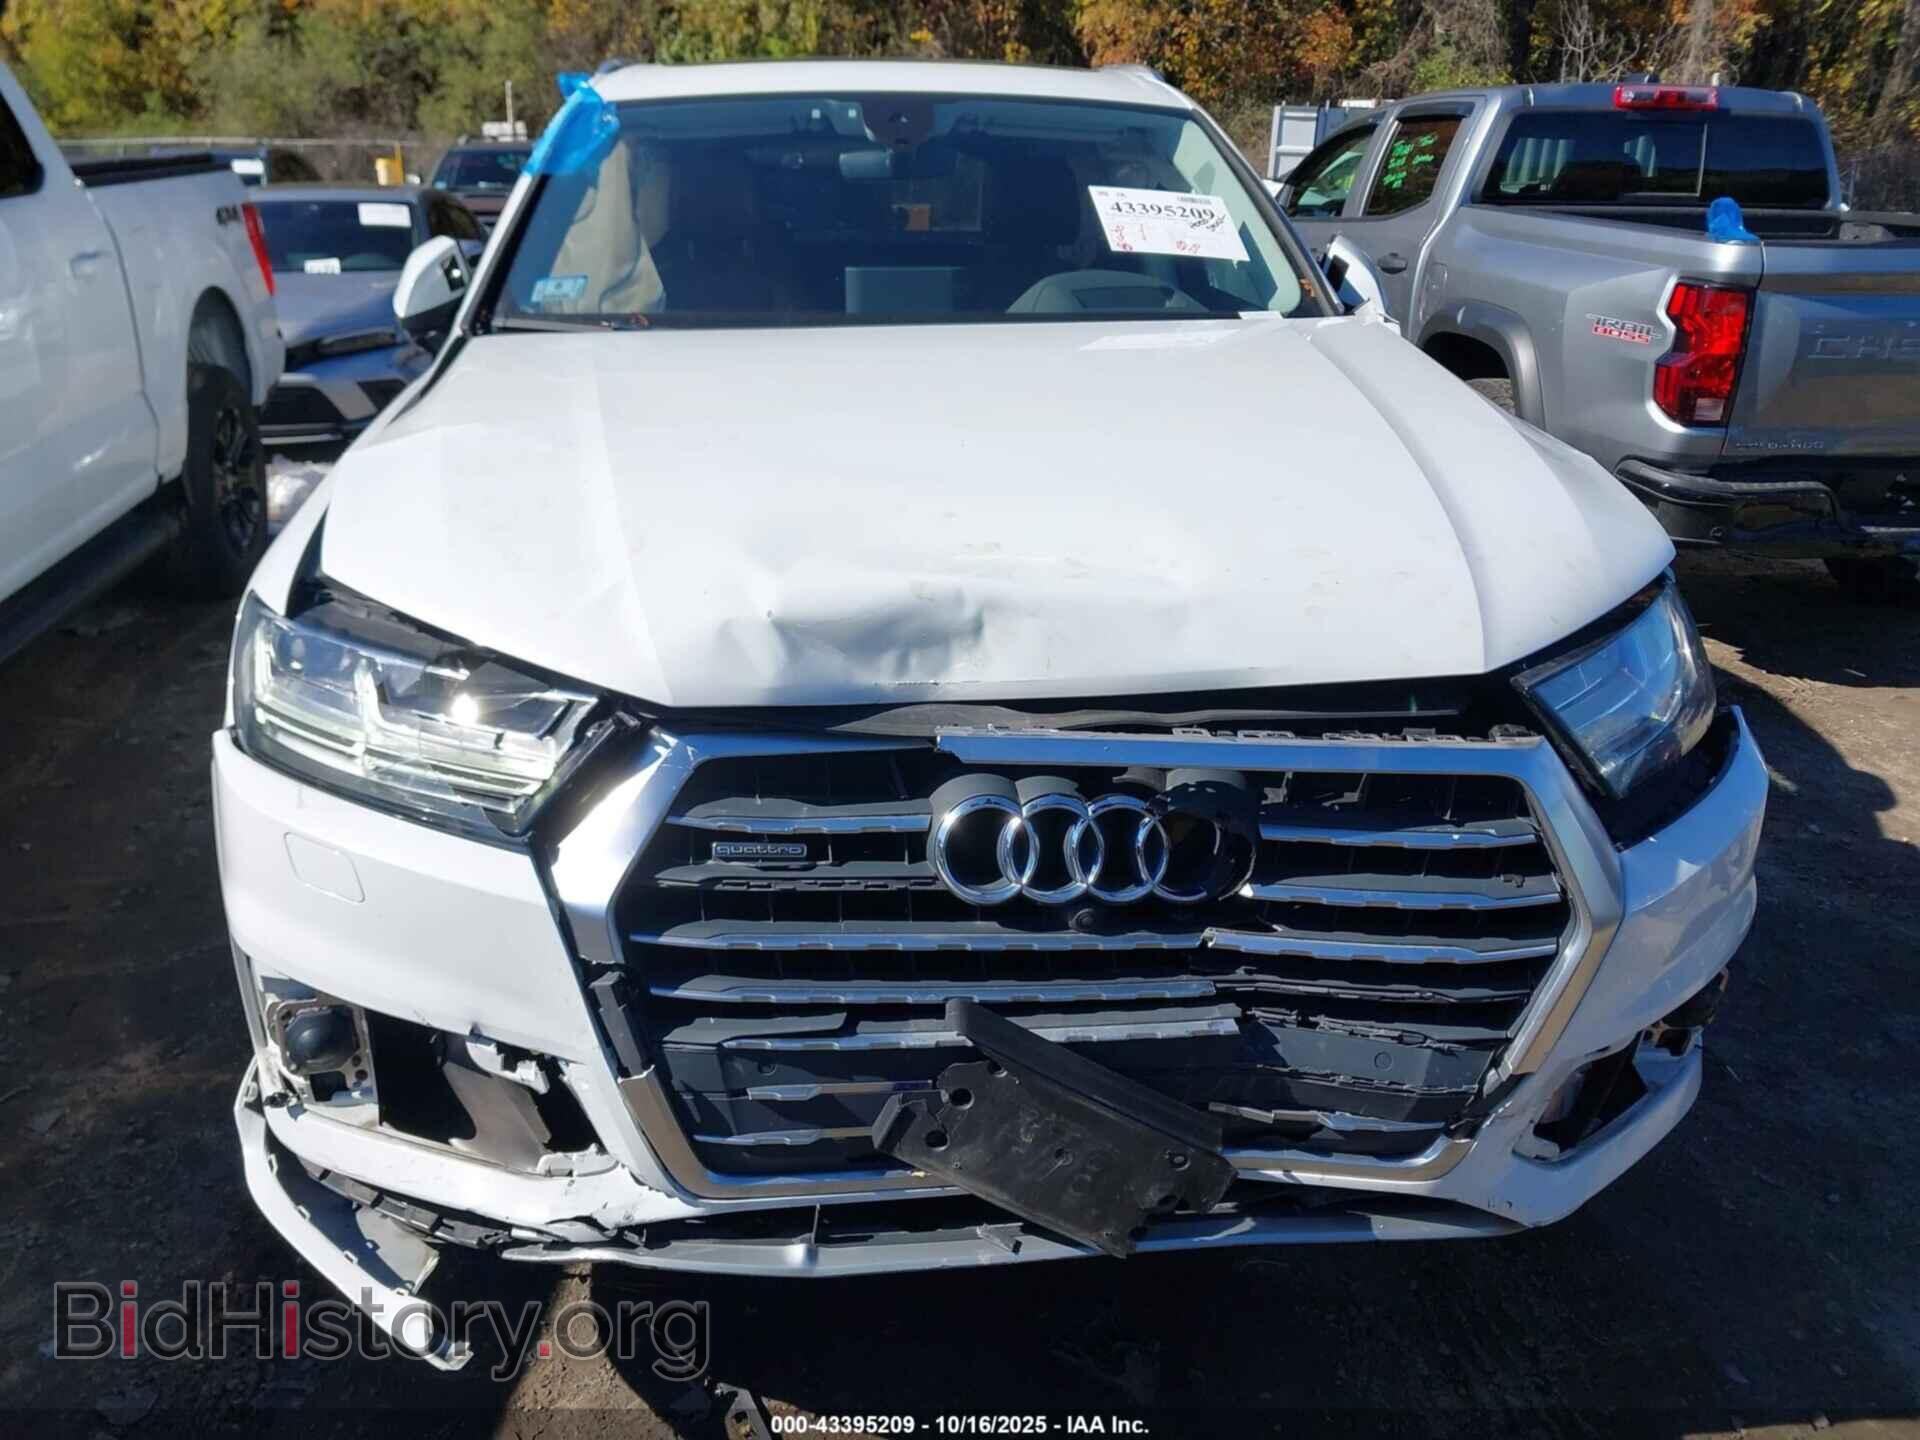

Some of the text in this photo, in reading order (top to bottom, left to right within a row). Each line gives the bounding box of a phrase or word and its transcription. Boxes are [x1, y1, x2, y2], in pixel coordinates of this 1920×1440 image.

[1111, 201, 1215, 221] 43395209
[1592, 325, 1650, 344] BOSS
[716, 844, 803, 857] quattro
